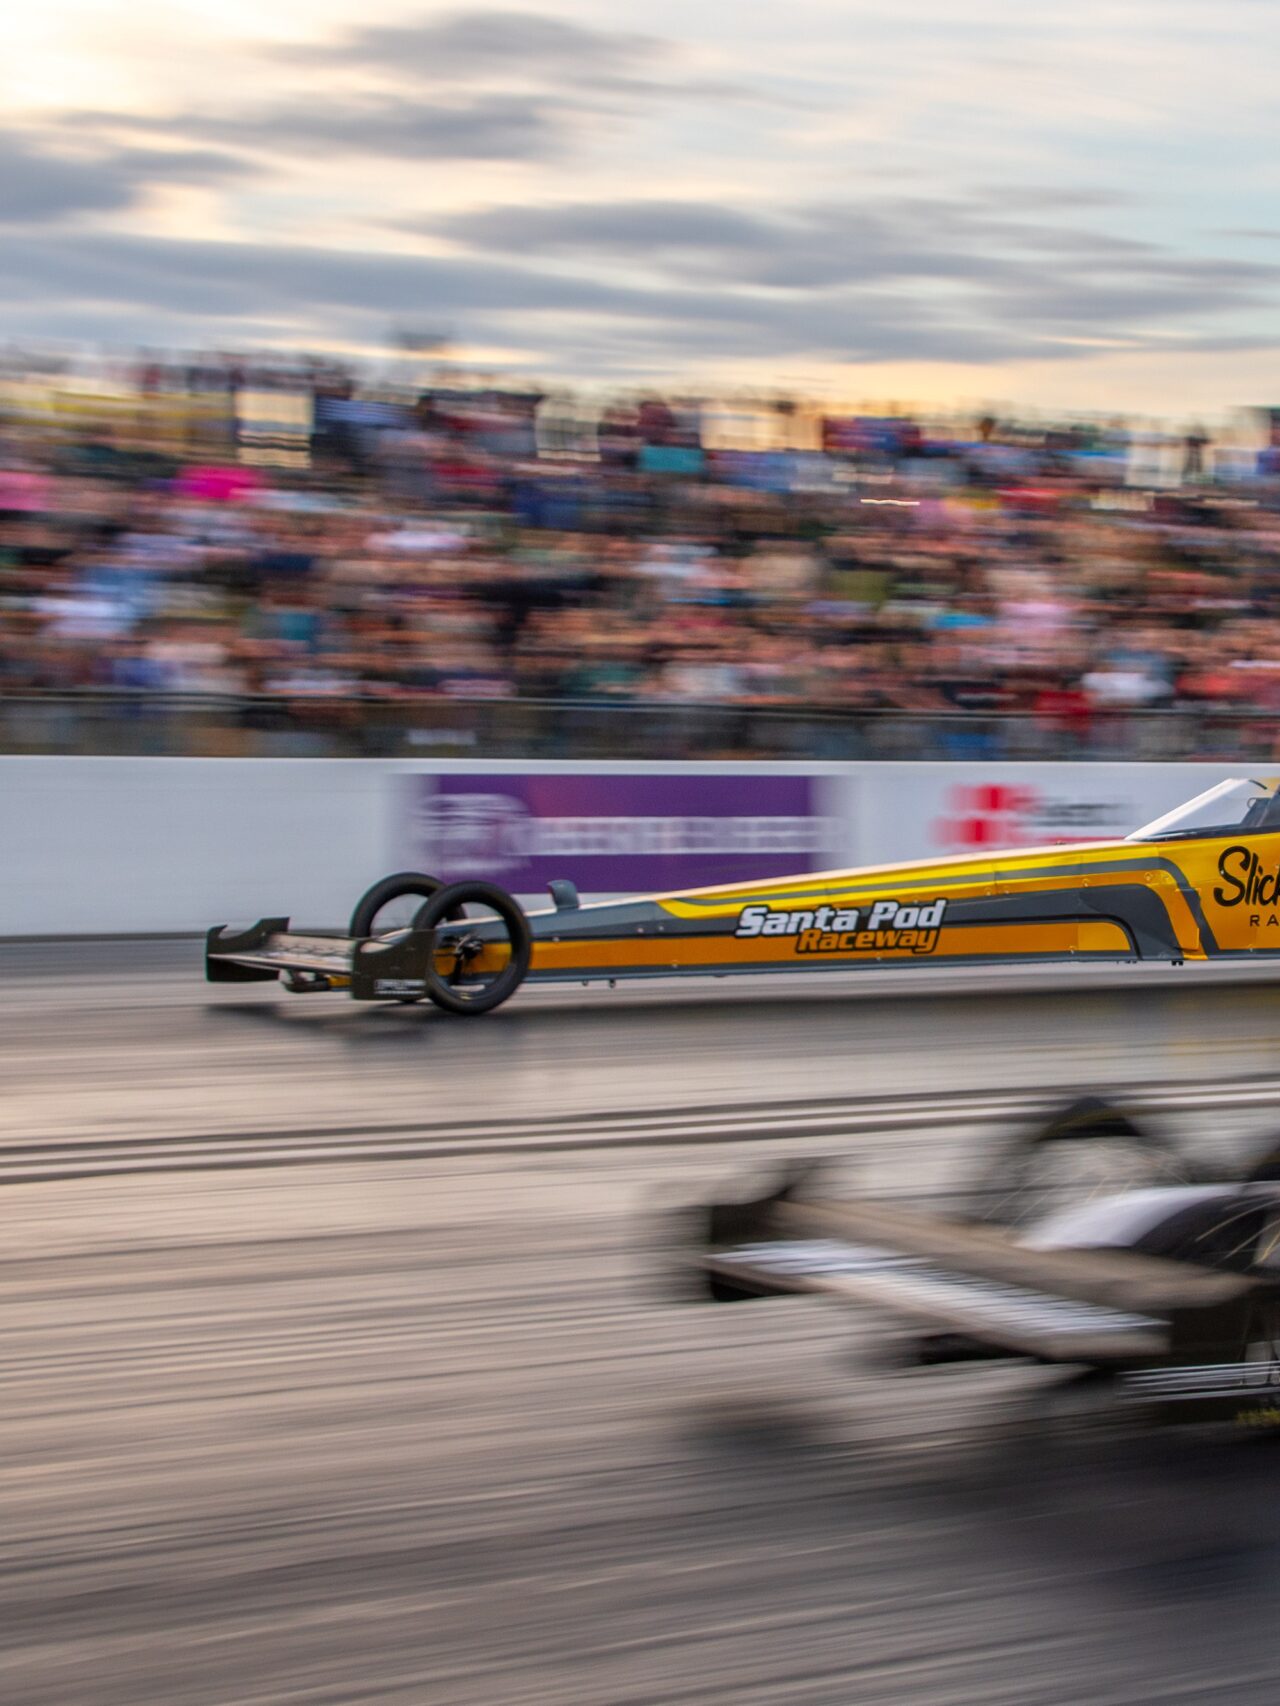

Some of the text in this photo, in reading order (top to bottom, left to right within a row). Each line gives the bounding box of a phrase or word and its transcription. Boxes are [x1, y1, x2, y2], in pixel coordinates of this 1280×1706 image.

[734, 898, 947, 936] Santa Pod
[797, 929, 938, 952] Raceway
